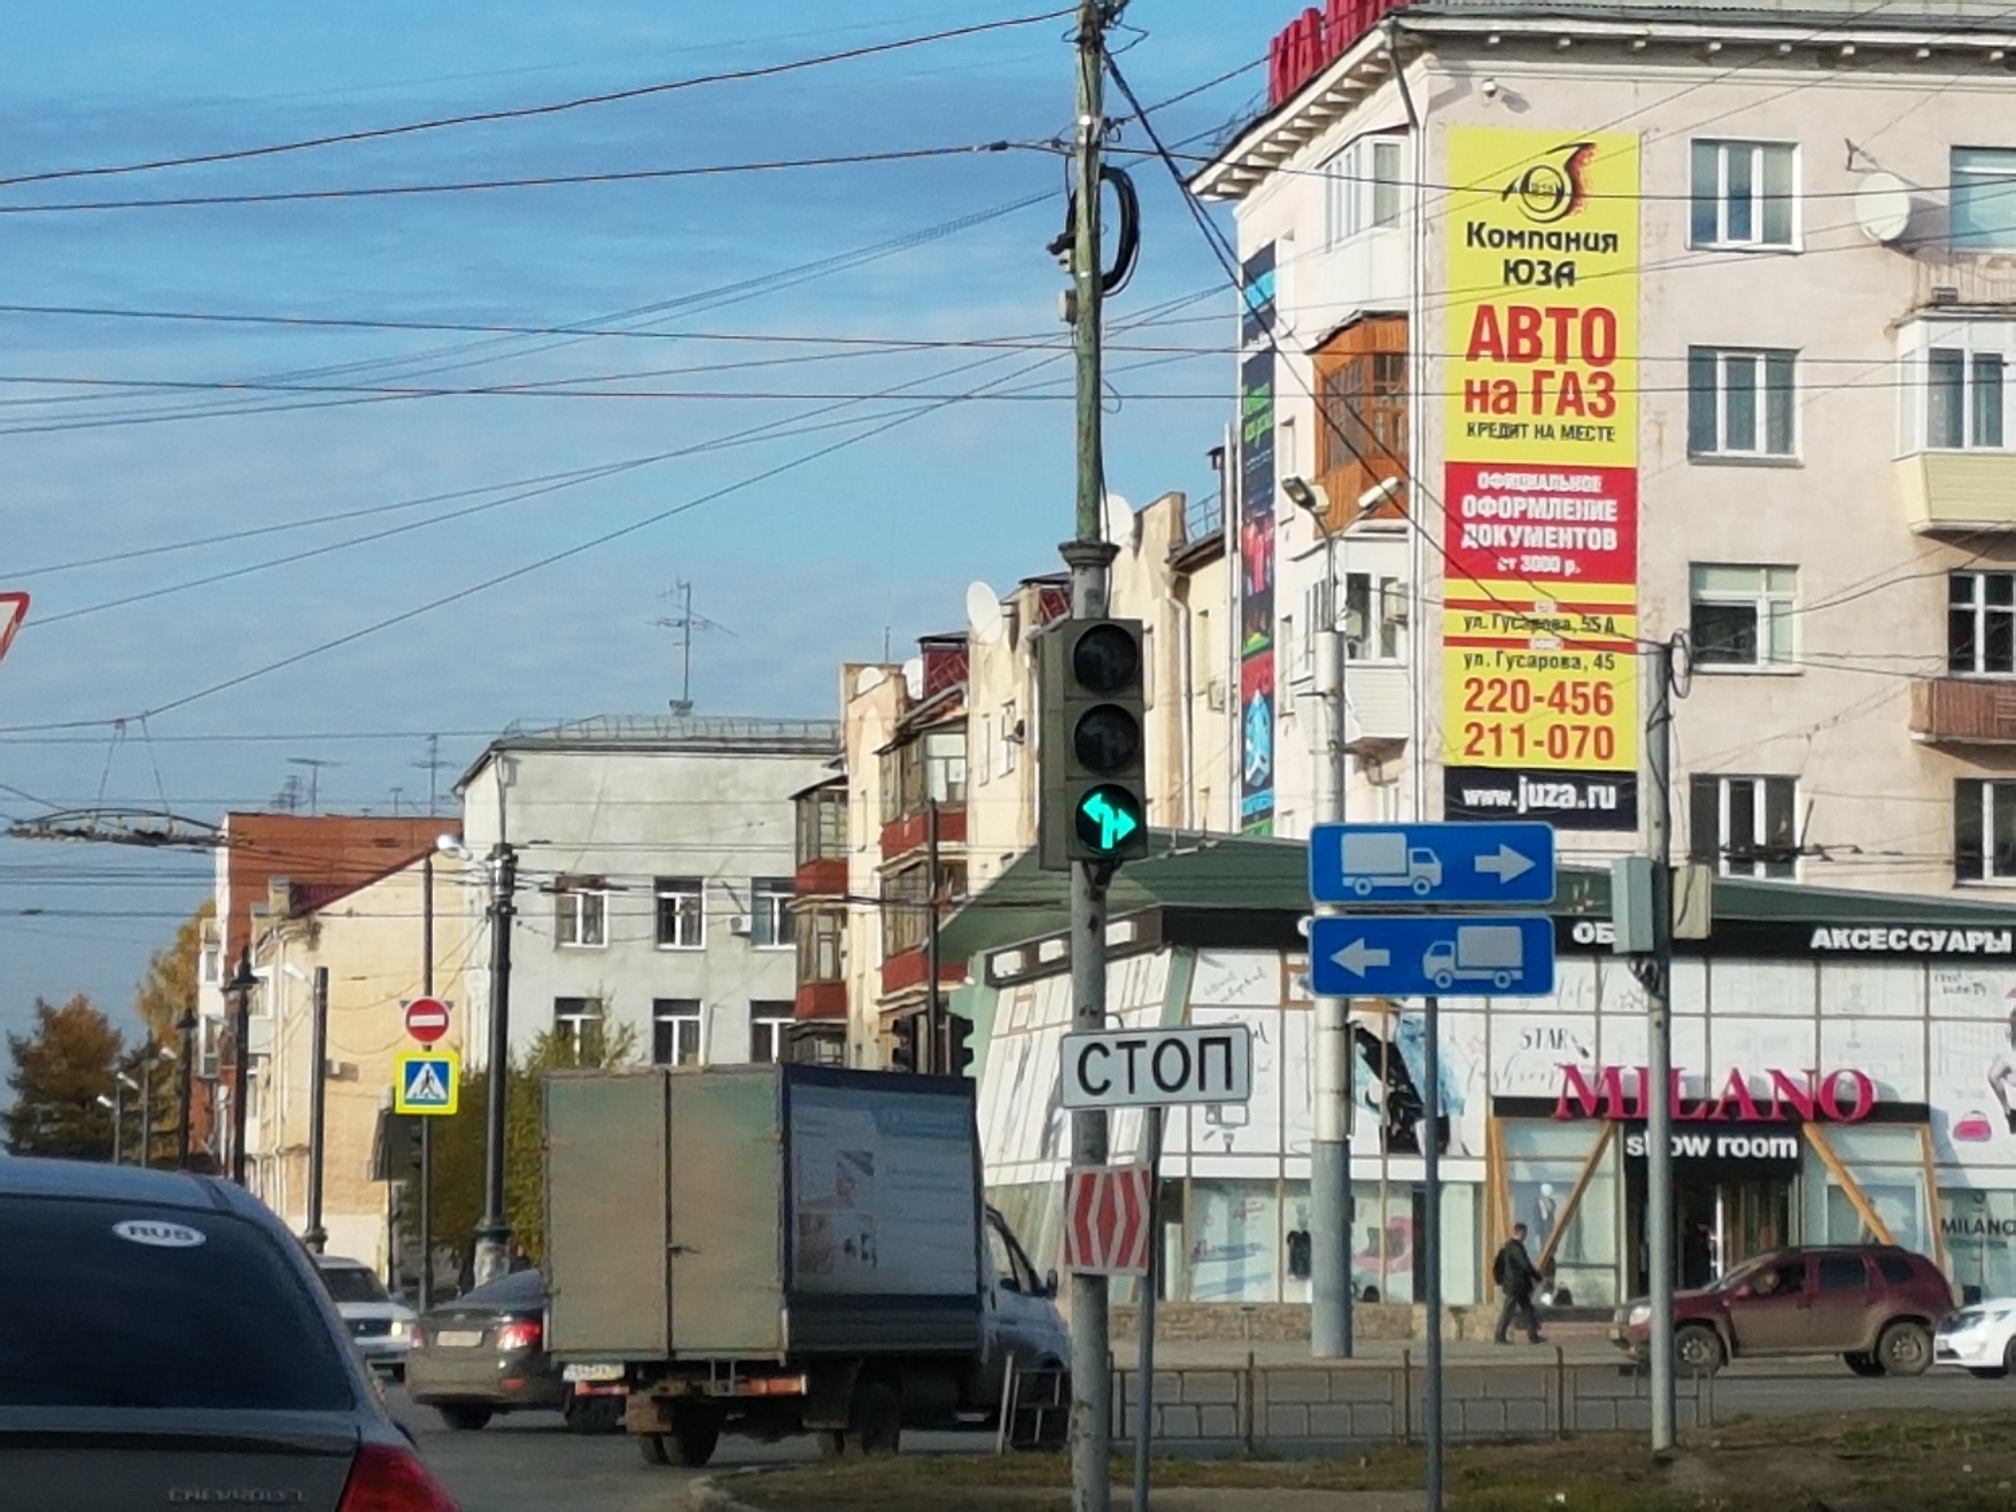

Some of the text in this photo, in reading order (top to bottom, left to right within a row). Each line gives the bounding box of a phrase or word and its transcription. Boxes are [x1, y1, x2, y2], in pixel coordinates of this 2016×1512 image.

[1466, 221, 1618, 254] Компания
[1503, 258, 1576, 289] ЮЗА
[1465, 304, 1617, 367] АВТО
[1464, 370, 1616, 418] на ГАЗ
[1466, 421, 1616, 443] КРЕДИТ НА МЕСТЕ
[1477, 472, 1603, 492] ОФИЦИАЛЬНОЕ
[1461, 494, 1618, 521] ОФОРМЛЕНИЕ
[1460, 523, 1618, 550] ДОКУМЕНТОВ
[1463, 615, 1487, 632] ул.
[1463, 650, 1615, 673] ул. Гусарова, 45
[1463, 677, 1614, 717] 220-456
[1463, 721, 1616, 761] 211-070
[1462, 775, 1617, 815] www.juza.ru
[1810, 927, 2013, 953] АКСЕССУАРЫ
[1077, 1036, 1233, 1096] СТОП
[1552, 1063, 1877, 1124] MILANO
[1716, 1136, 1799, 1159] room
[128, 1226, 194, 1241] RUS
